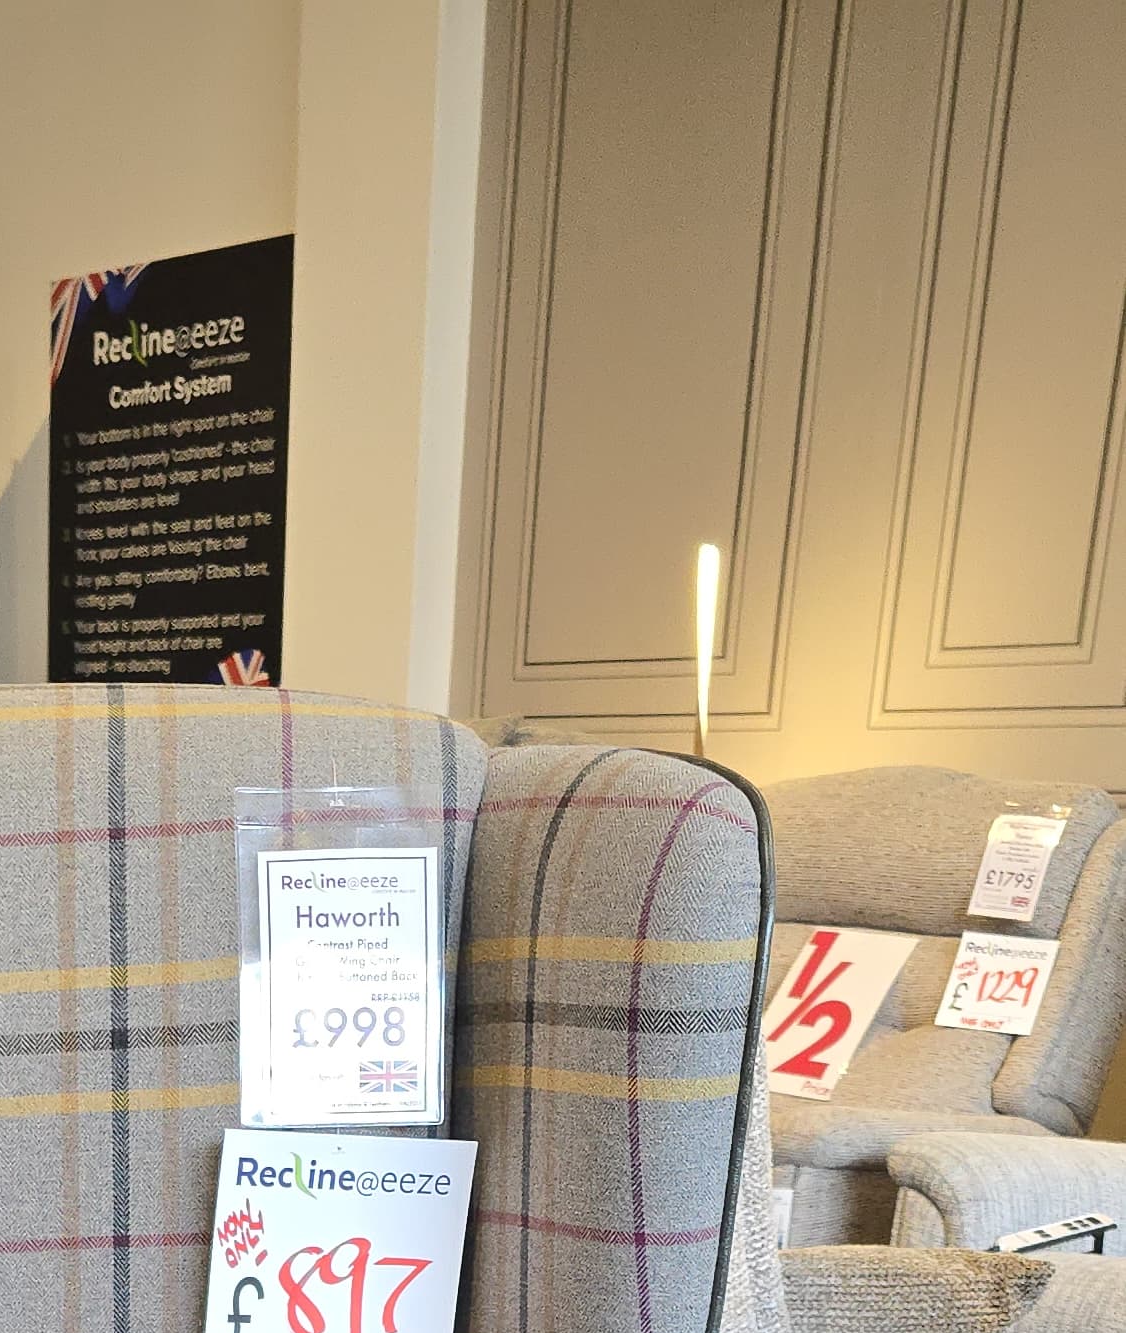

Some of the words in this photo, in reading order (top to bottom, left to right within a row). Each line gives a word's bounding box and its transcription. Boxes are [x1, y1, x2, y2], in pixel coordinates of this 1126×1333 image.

[108, 380, 172, 409] Comfort
[174, 374, 232, 404] System
[281, 870, 399, 893] Recline@eeze
[984, 868, 1037, 891] £1795
[296, 902, 400, 929] Haworth
[357, 937, 389, 953] Piped
[948, 982, 969, 1011] £
[977, 967, 1039, 1008] 1229
[292, 1006, 406, 1049] £998
[235, 1152, 451, 1200] Recline@eeze
